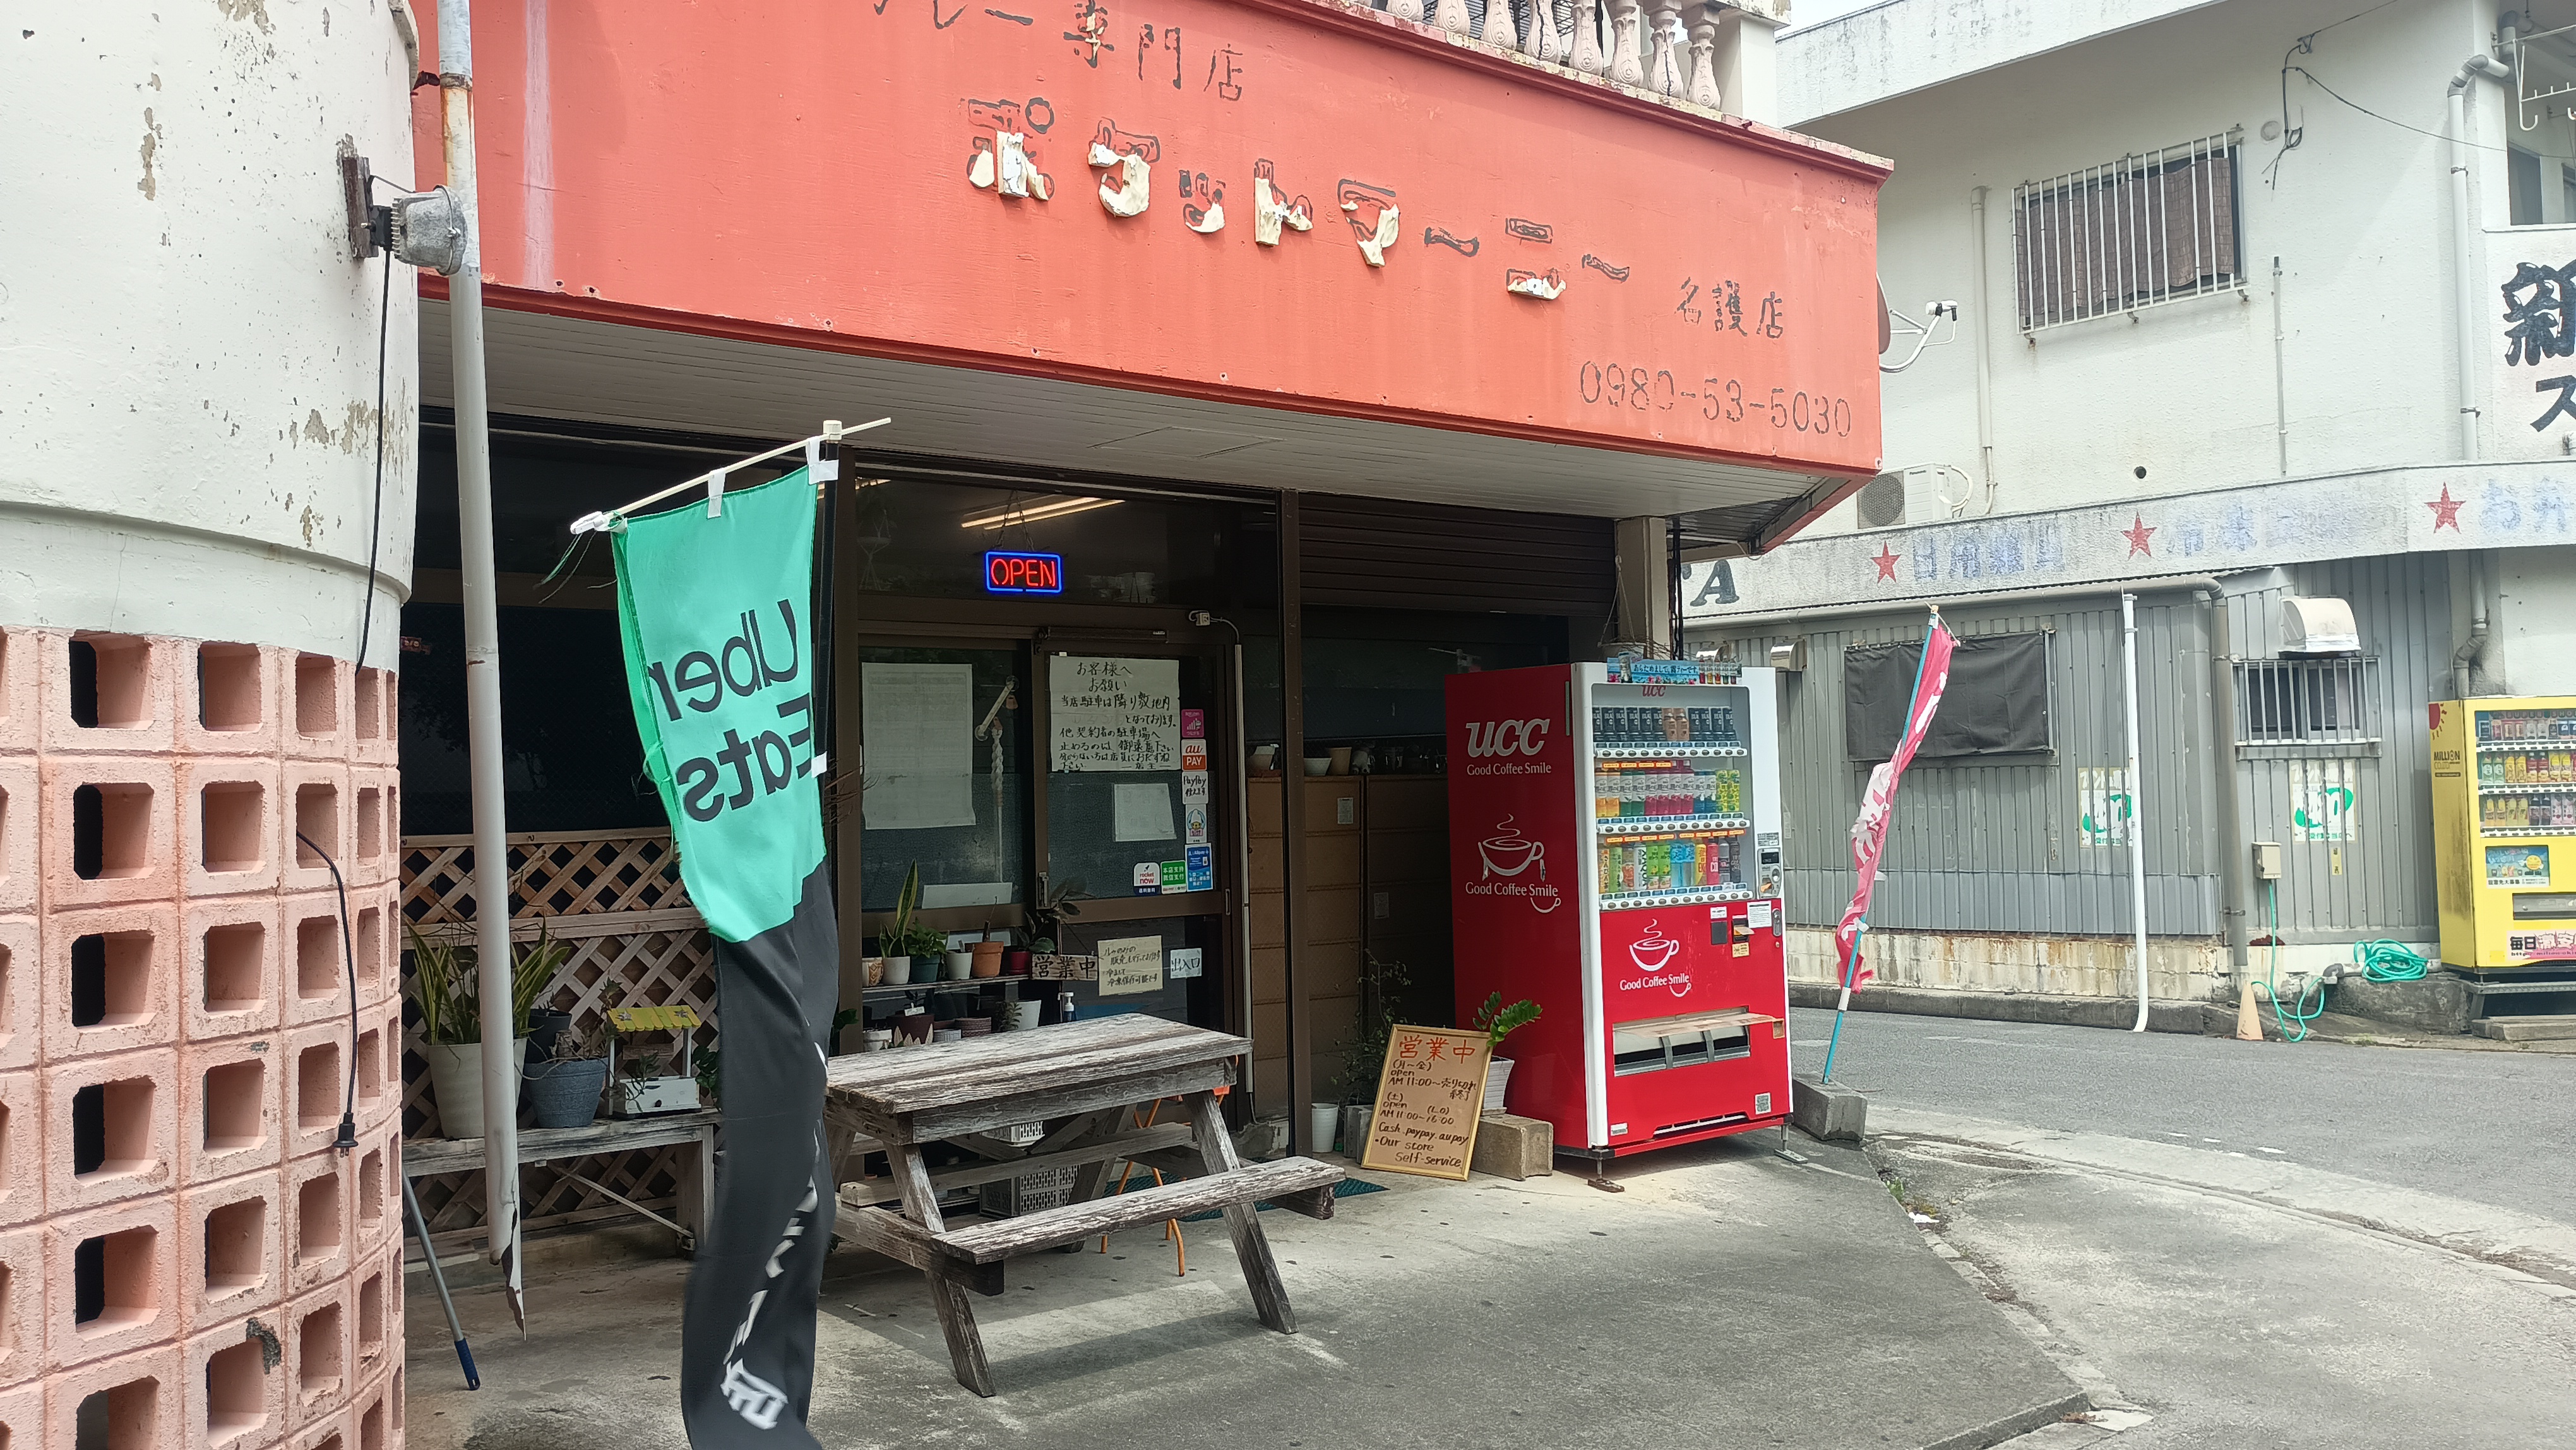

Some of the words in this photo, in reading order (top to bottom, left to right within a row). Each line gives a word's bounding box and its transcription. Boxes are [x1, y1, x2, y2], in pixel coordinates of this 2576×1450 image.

[1675, 277, 1784, 339] 名護店
[1580, 361, 1851, 438] 0980-53-5030
[991, 559, 1056, 587] OPEN
[1077, 661, 1132, 676] お客様へ
[1088, 678, 1127, 693] お願い
[1186, 745, 1203, 753] au
[2434, 750, 2460, 761] MILLION
[1186, 757, 1202, 765] PAY
[1467, 764, 1491, 776] Good
[1493, 762, 1523, 775] Coffee
[1525, 762, 1552, 774] Smile
[1184, 775, 1207, 787] PayPay
[1465, 882, 1492, 895] Good
[1494, 882, 1527, 896] Coffee
[1529, 884, 1558, 897] Smile
[1035, 956, 1096, 979] 営業中
[1171, 957, 1200, 973] 出入口
[1619, 978, 1642, 991] Good
[1642, 976, 1667, 988] Coffee
[1668, 973, 1690, 985] Smile
[1399, 1034, 1476, 1064] 営業中
[1388, 1077, 1404, 1086] AM
[1450, 1089, 1470, 1101] 終了
[1380, 1110, 1395, 1118] AM
[1405, 1141, 1434, 1151] store
